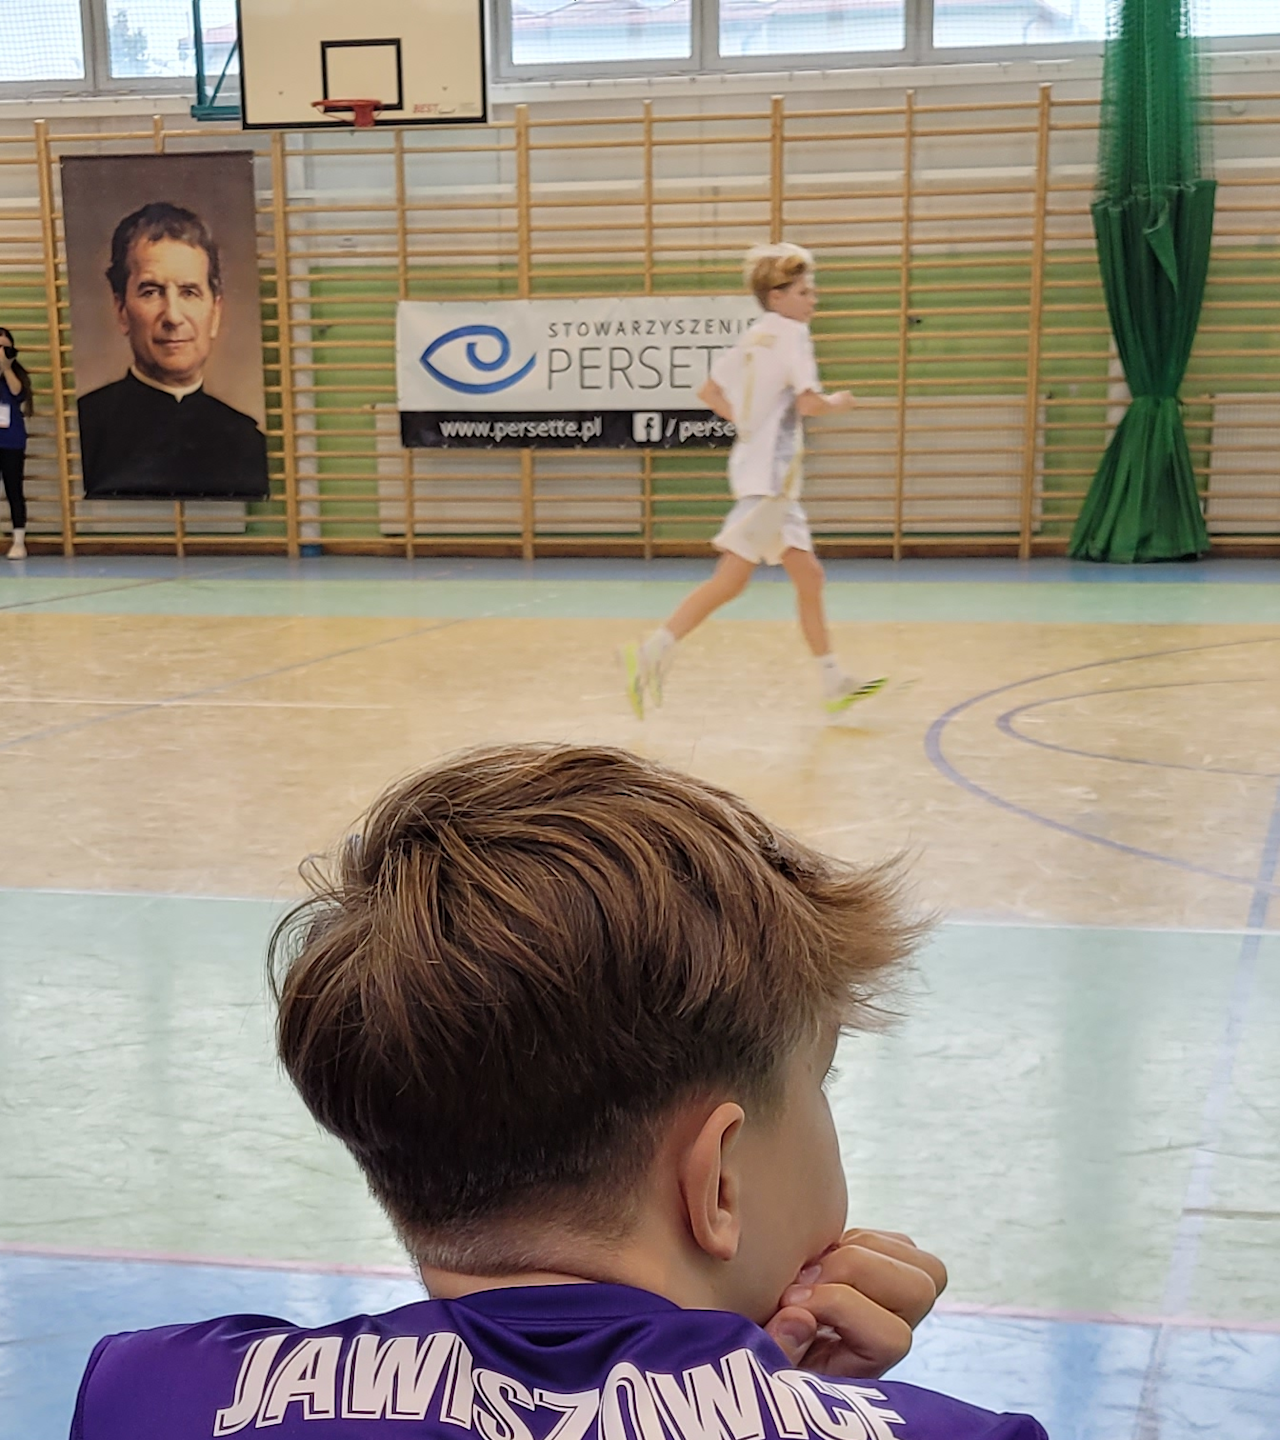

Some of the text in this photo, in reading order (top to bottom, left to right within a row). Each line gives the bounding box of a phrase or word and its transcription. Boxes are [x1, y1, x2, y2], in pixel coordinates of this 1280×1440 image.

[548, 344, 734, 390] PERSET
[438, 416, 603, 443] www.persette.pl
[678, 420, 737, 443] perse
